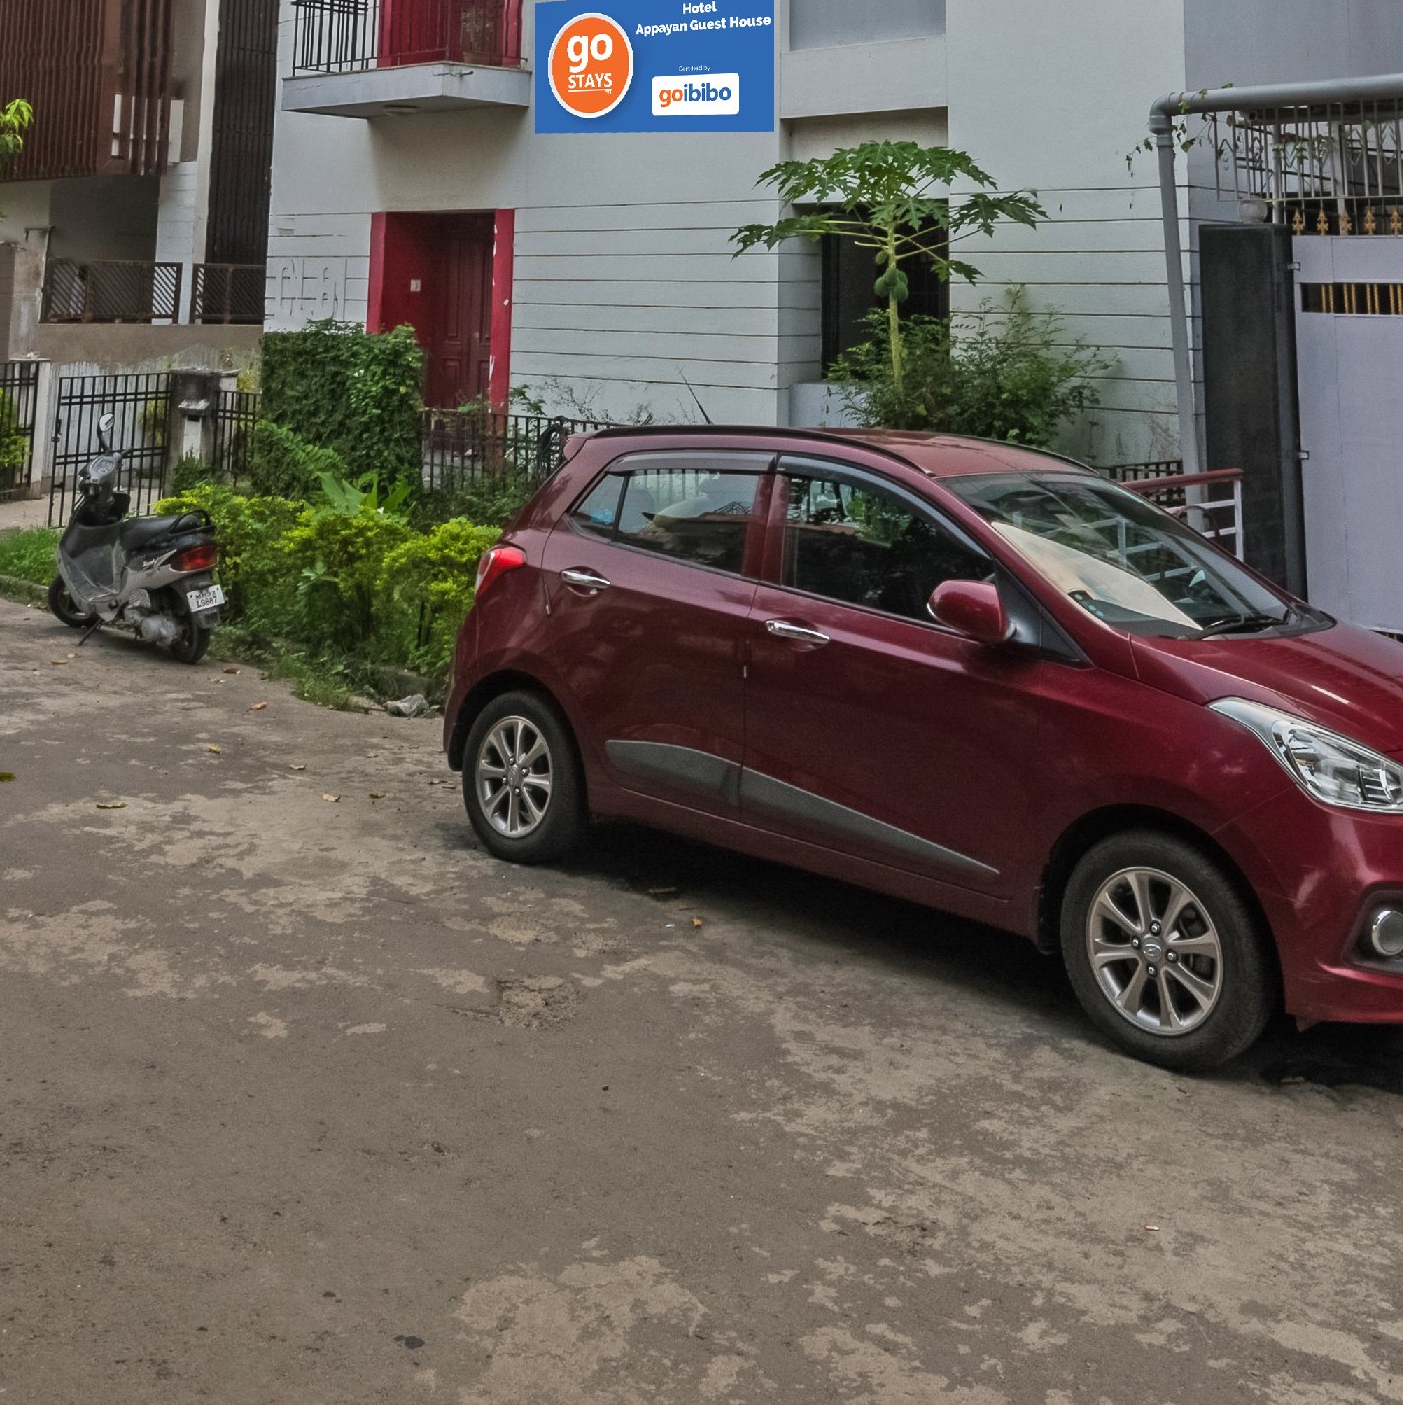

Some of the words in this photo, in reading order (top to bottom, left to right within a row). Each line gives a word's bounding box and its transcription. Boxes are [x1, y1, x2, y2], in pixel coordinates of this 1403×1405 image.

[682, 0, 717, 15] Hotel
[635, 23, 688, 37] Appayan
[689, 18, 727, 31] Guest
[729, 16, 772, 28] House
[567, 33, 613, 74] go
[568, 72, 613, 89] STAYS
[659, 82, 732, 108] goibibo
